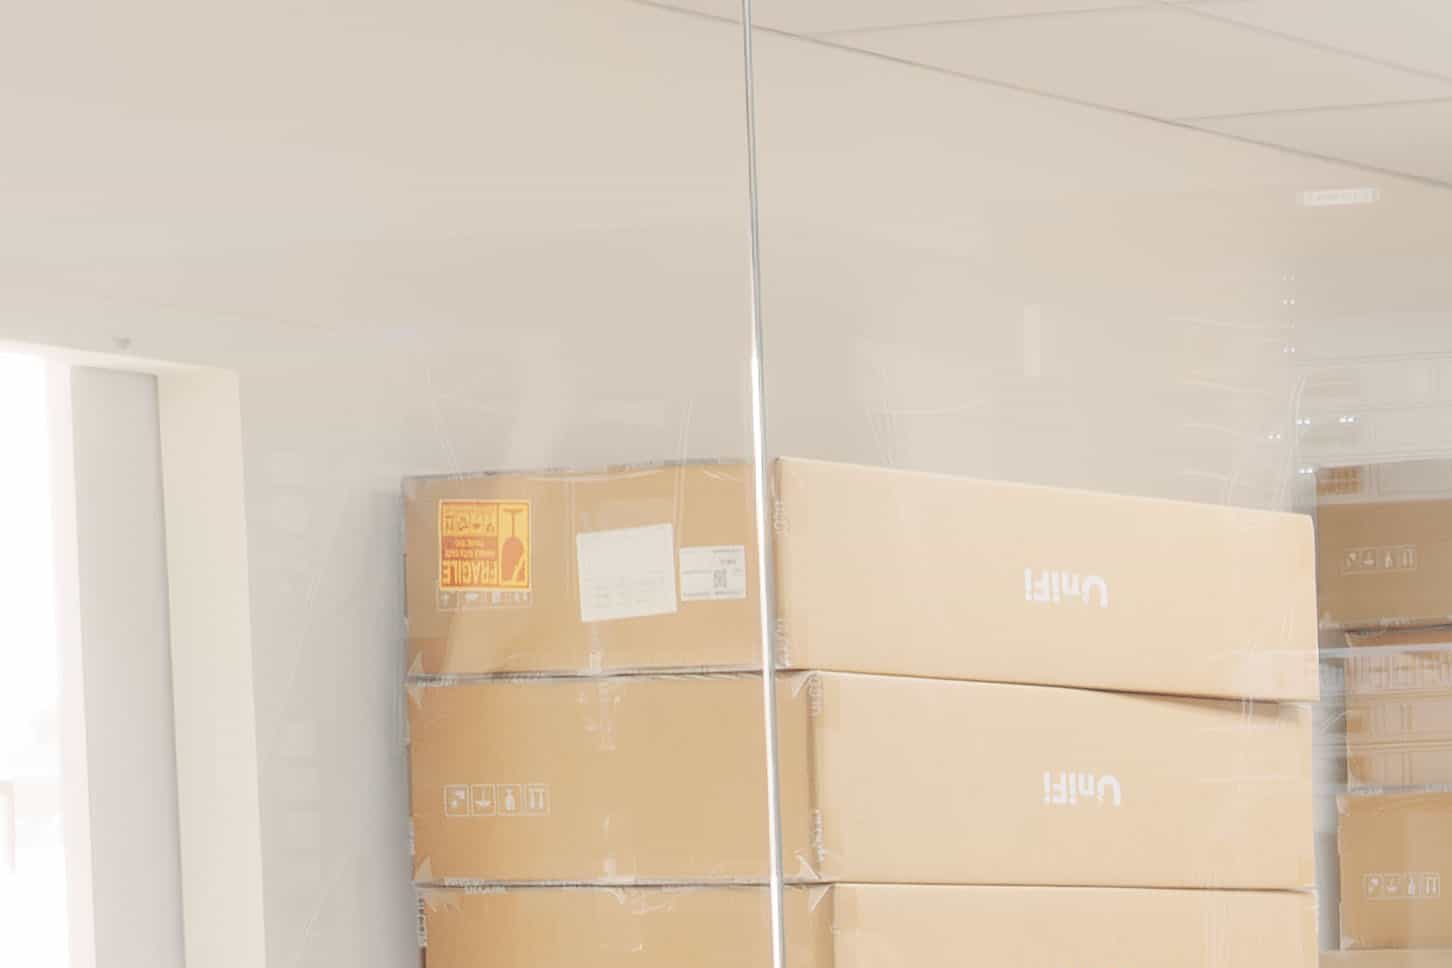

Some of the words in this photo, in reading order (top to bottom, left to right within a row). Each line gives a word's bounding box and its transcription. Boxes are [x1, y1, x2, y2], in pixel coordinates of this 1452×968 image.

[442, 559, 497, 584] FRAGILE
[1023, 568, 1109, 608] UniFi
[1042, 771, 1121, 806] UniFi
